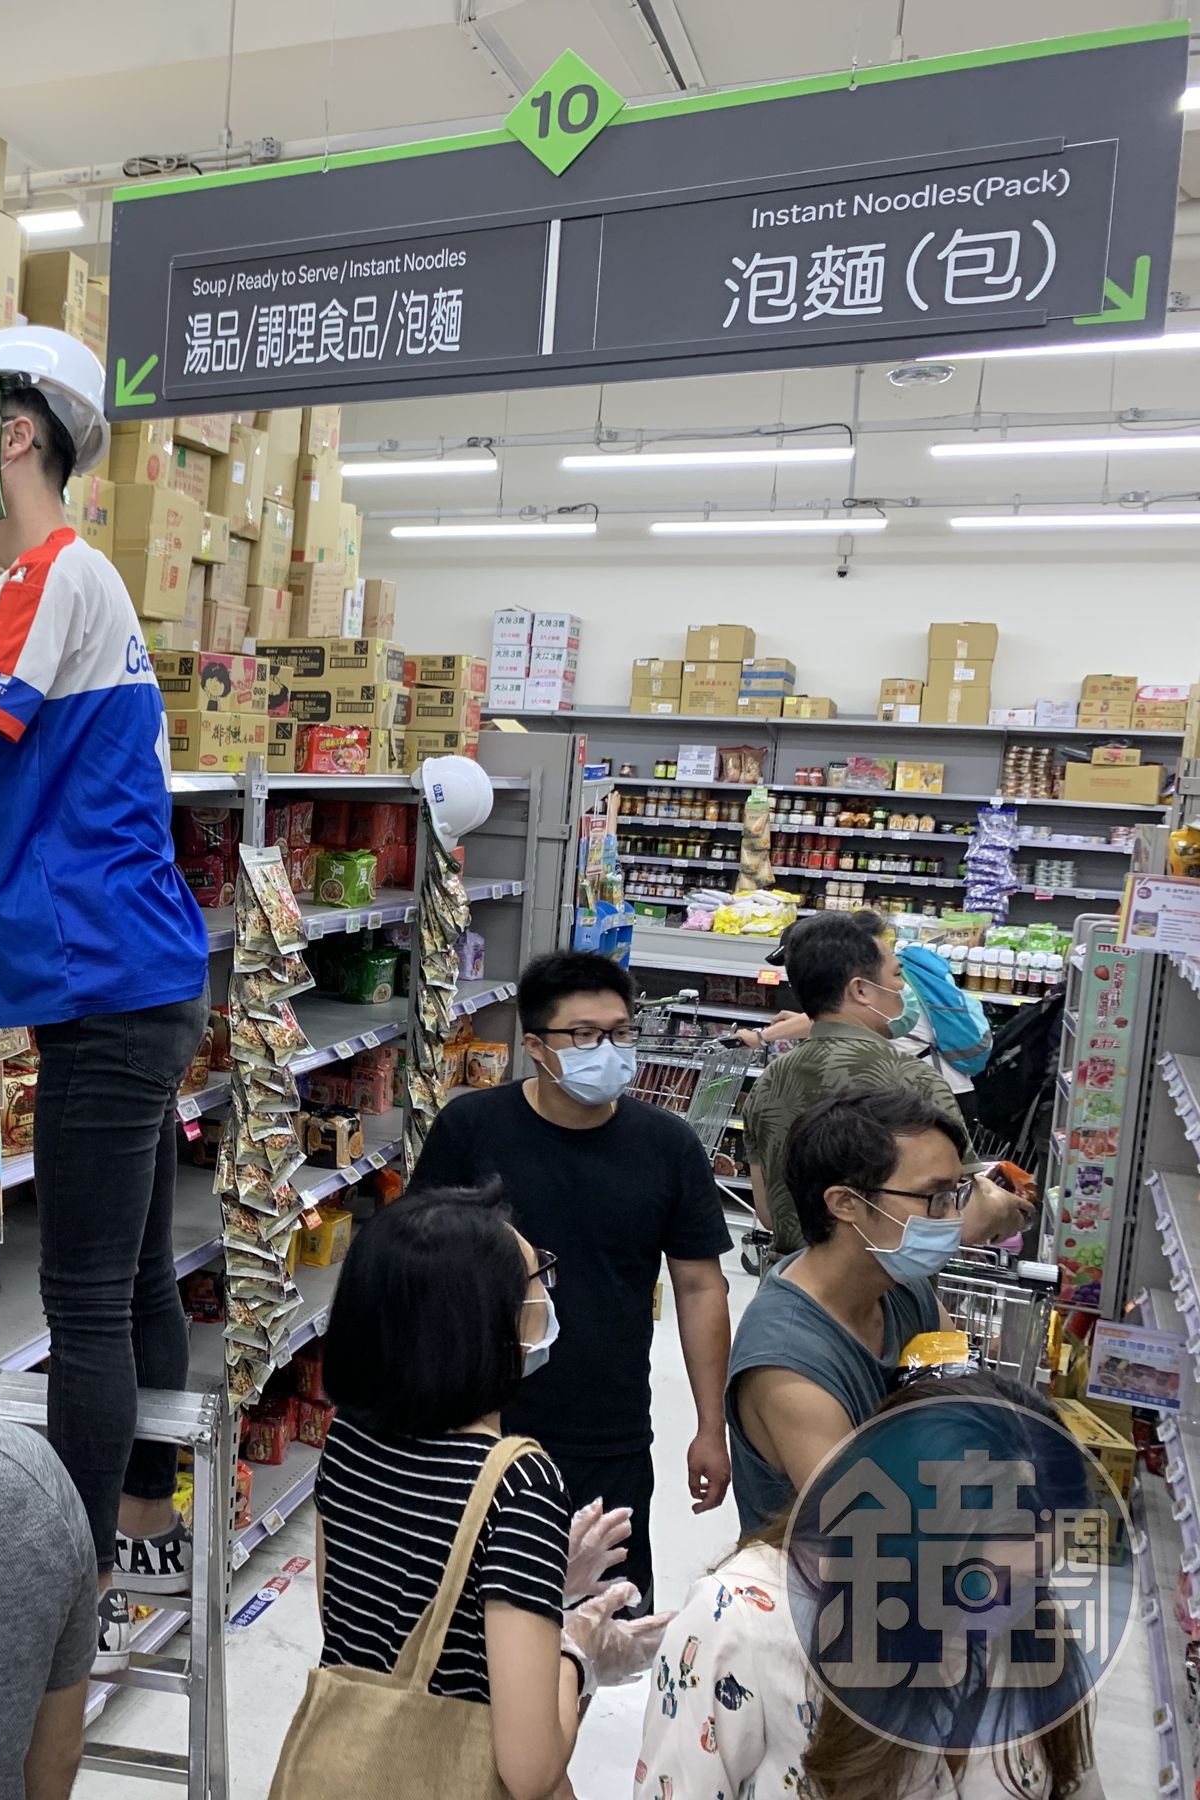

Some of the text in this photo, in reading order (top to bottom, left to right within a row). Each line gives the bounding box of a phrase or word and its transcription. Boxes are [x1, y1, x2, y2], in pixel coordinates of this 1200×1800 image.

[531, 84, 600, 139] 10
[752, 168, 1071, 230] Instant Noodles(Pack)
[193, 277, 227, 300] Soup
[236, 270, 278, 293] Ready
[280, 268, 296, 286] to
[299, 264, 338, 284] Serve
[350, 257, 401, 278] Instant
[403, 248, 467, 271] Noodles
[722, 219, 1057, 328] 泡麵(包)
[183, 287, 464, 376] 湯品/調理食品/泡麵
